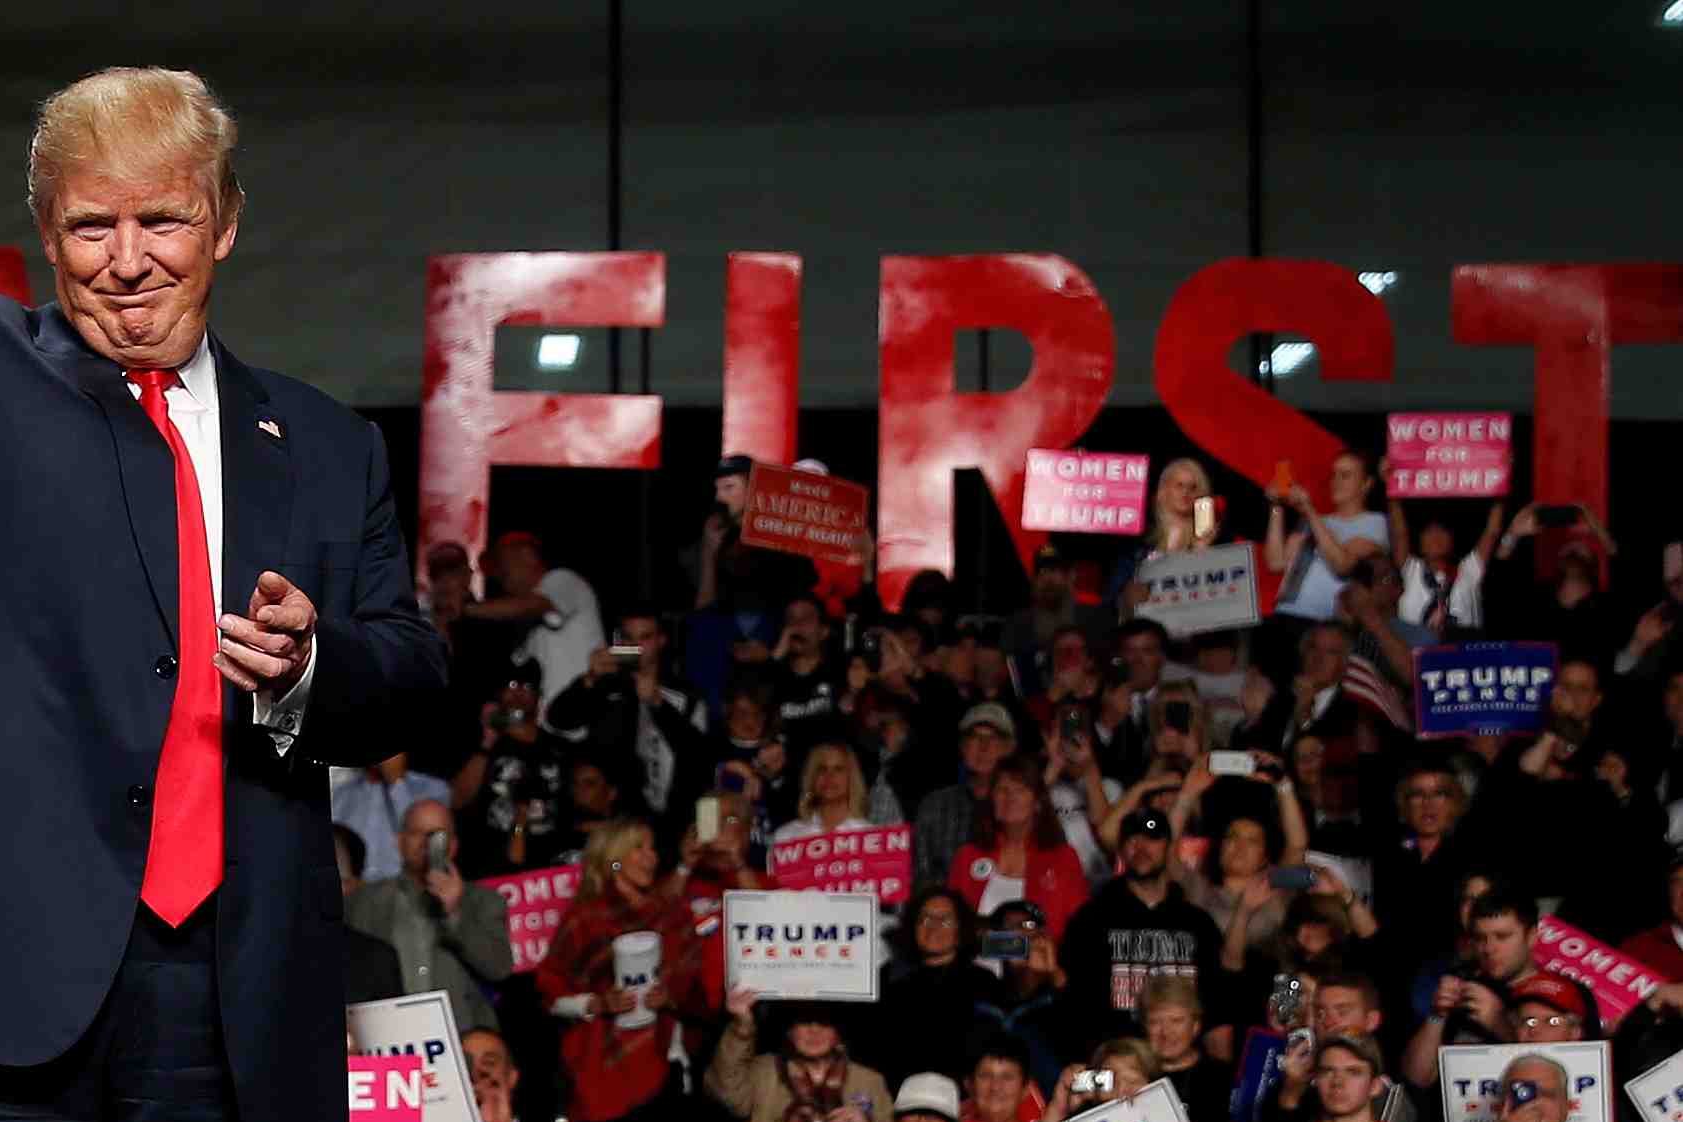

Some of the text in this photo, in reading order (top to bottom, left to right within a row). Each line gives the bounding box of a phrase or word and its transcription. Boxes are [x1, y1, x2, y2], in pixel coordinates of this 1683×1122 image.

[421, 250, 1683, 613] FIRST
[1390, 418, 1510, 443] WOMEN
[1029, 458, 1146, 481] WOMEN
[1394, 467, 1506, 491] TRUMP
[1030, 504, 1140, 528] TRUMP
[1147, 566, 1247, 594] TRUMP
[1421, 666, 1553, 689] TRUMP
[773, 829, 911, 867] WOMEN
[813, 859, 862, 879] FOR
[733, 923, 867, 944] TRUMP
[1538, 918, 1659, 999] WOMEN
[1453, 1076, 1596, 1098] TRP
